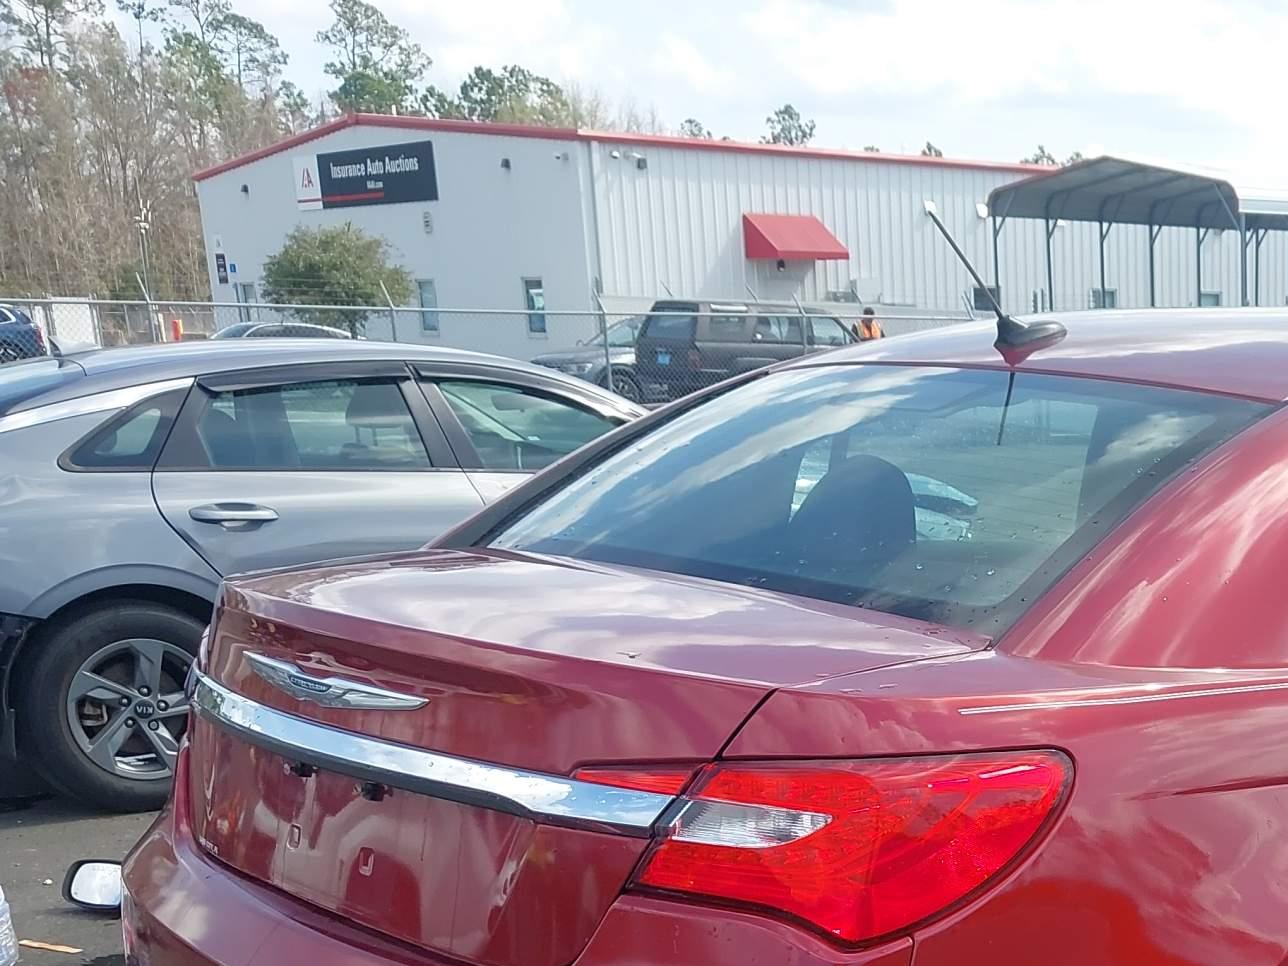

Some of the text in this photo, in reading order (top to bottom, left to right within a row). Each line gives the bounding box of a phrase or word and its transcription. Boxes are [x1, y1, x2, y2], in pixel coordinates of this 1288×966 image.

[330, 154, 418, 178] Insurance Auto Auctions
